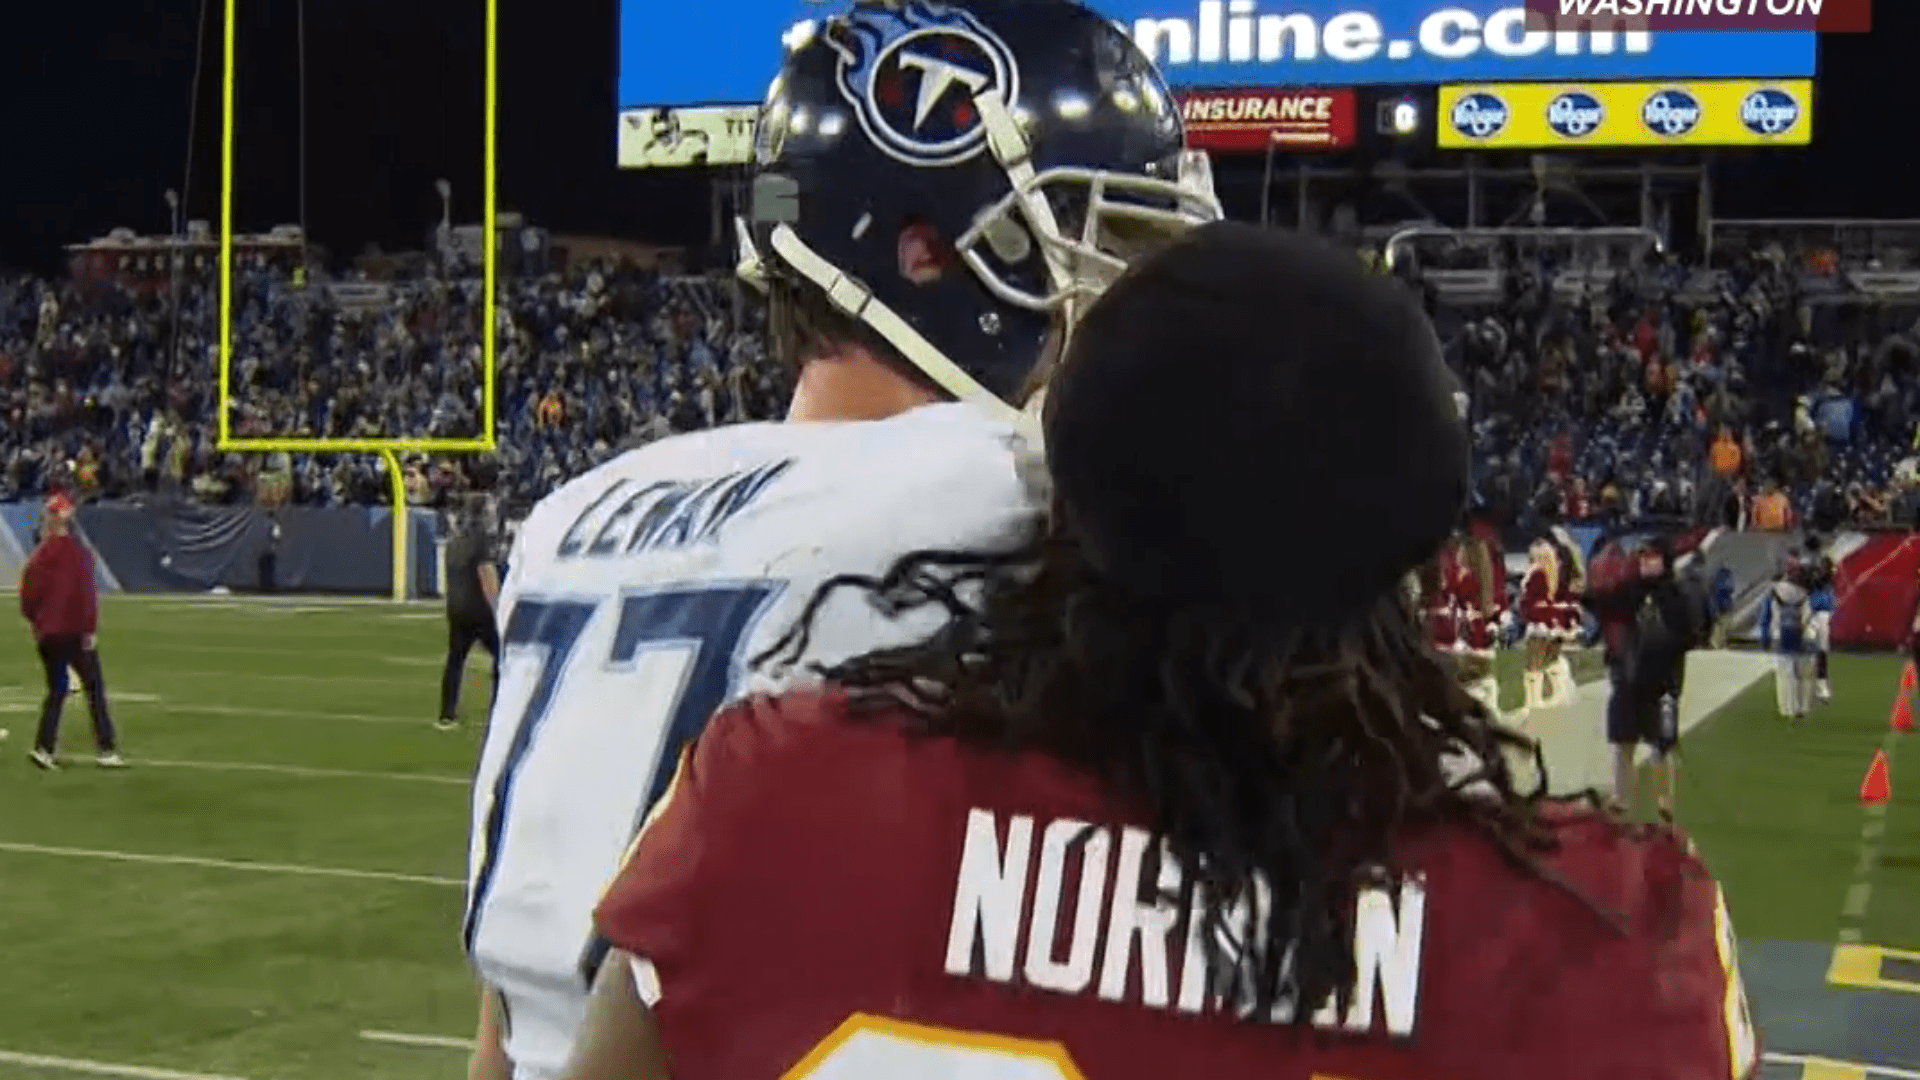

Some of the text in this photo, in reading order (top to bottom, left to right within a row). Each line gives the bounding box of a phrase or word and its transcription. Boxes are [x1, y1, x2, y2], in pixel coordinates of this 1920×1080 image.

[1184, 96, 1333, 121] INSURANCE
[555, 457, 800, 560] LEWAN
[944, 806, 1427, 1038] NORMN
